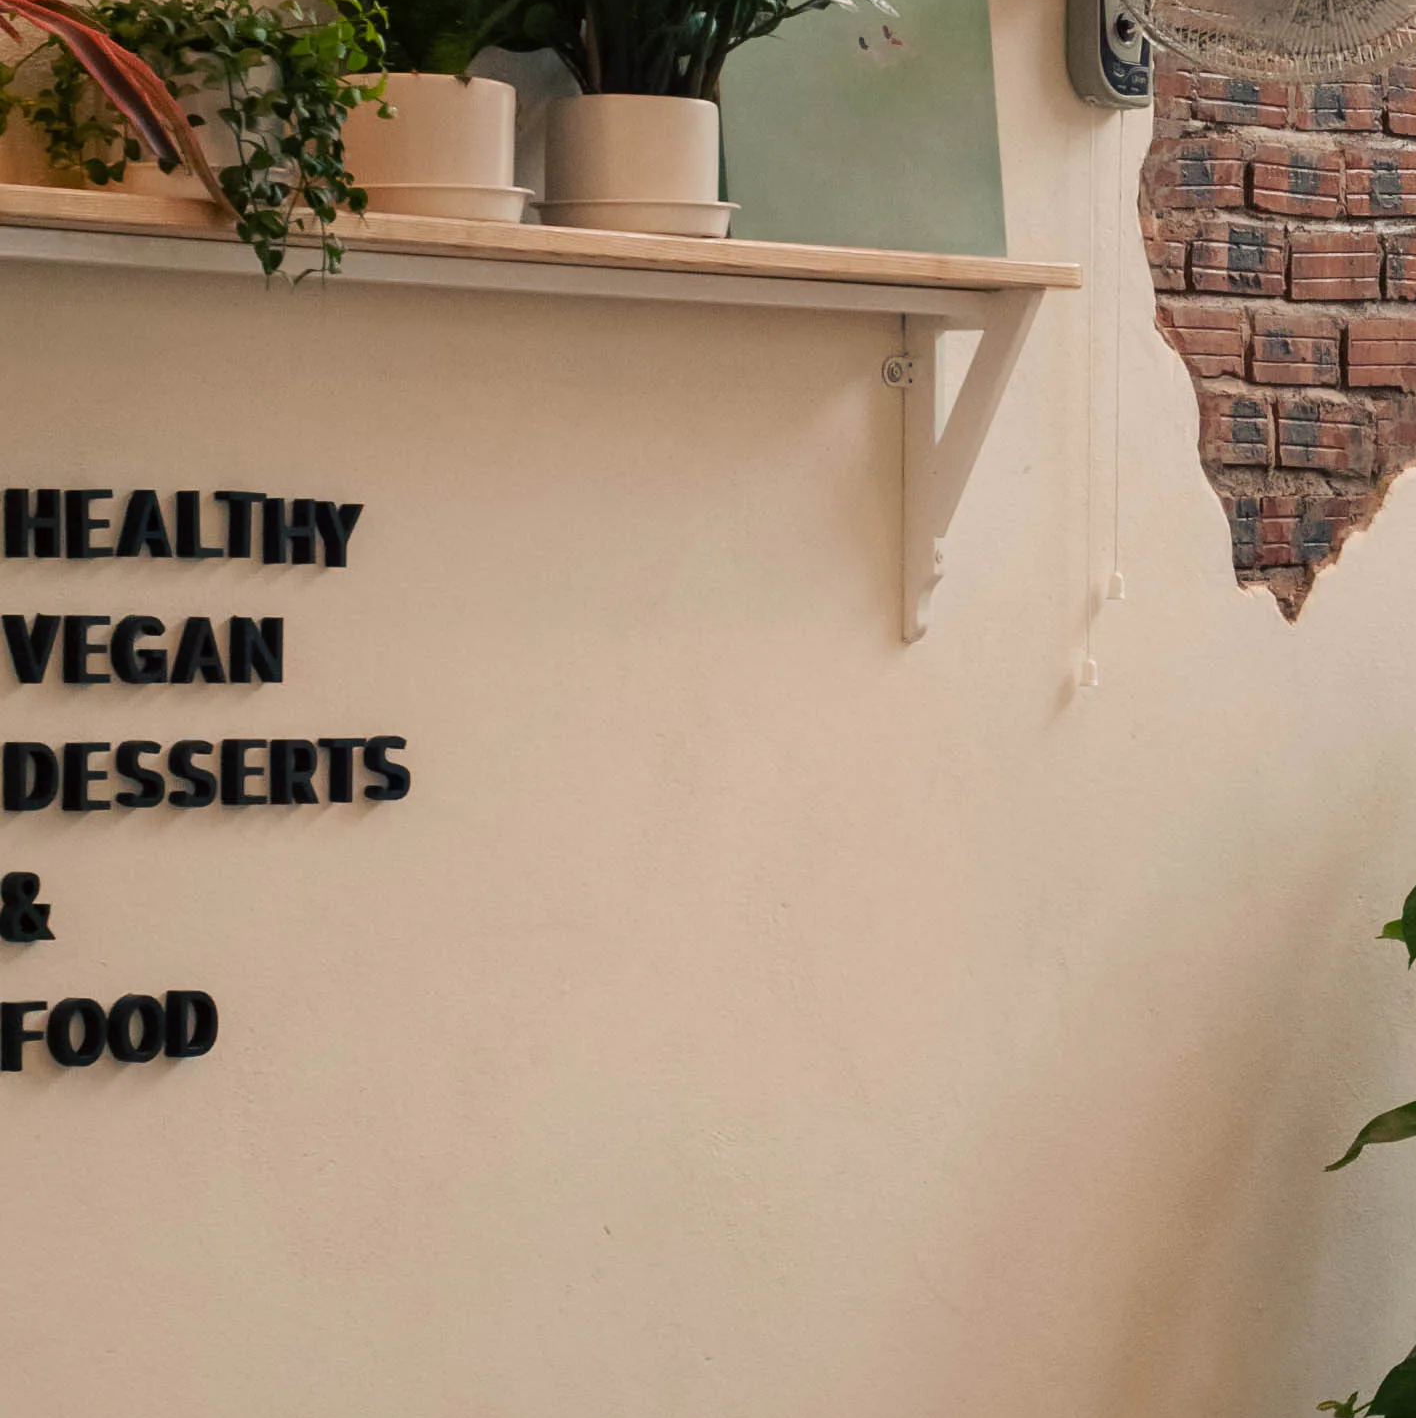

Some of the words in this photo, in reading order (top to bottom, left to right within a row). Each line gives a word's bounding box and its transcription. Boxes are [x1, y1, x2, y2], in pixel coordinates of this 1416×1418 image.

[4, 489, 364, 568] HEALTHY
[2, 614, 284, 684] VEGAN
[3, 735, 411, 811] DESSERTS
[0, 871, 56, 943] &
[0, 990, 218, 1071] FOOD
